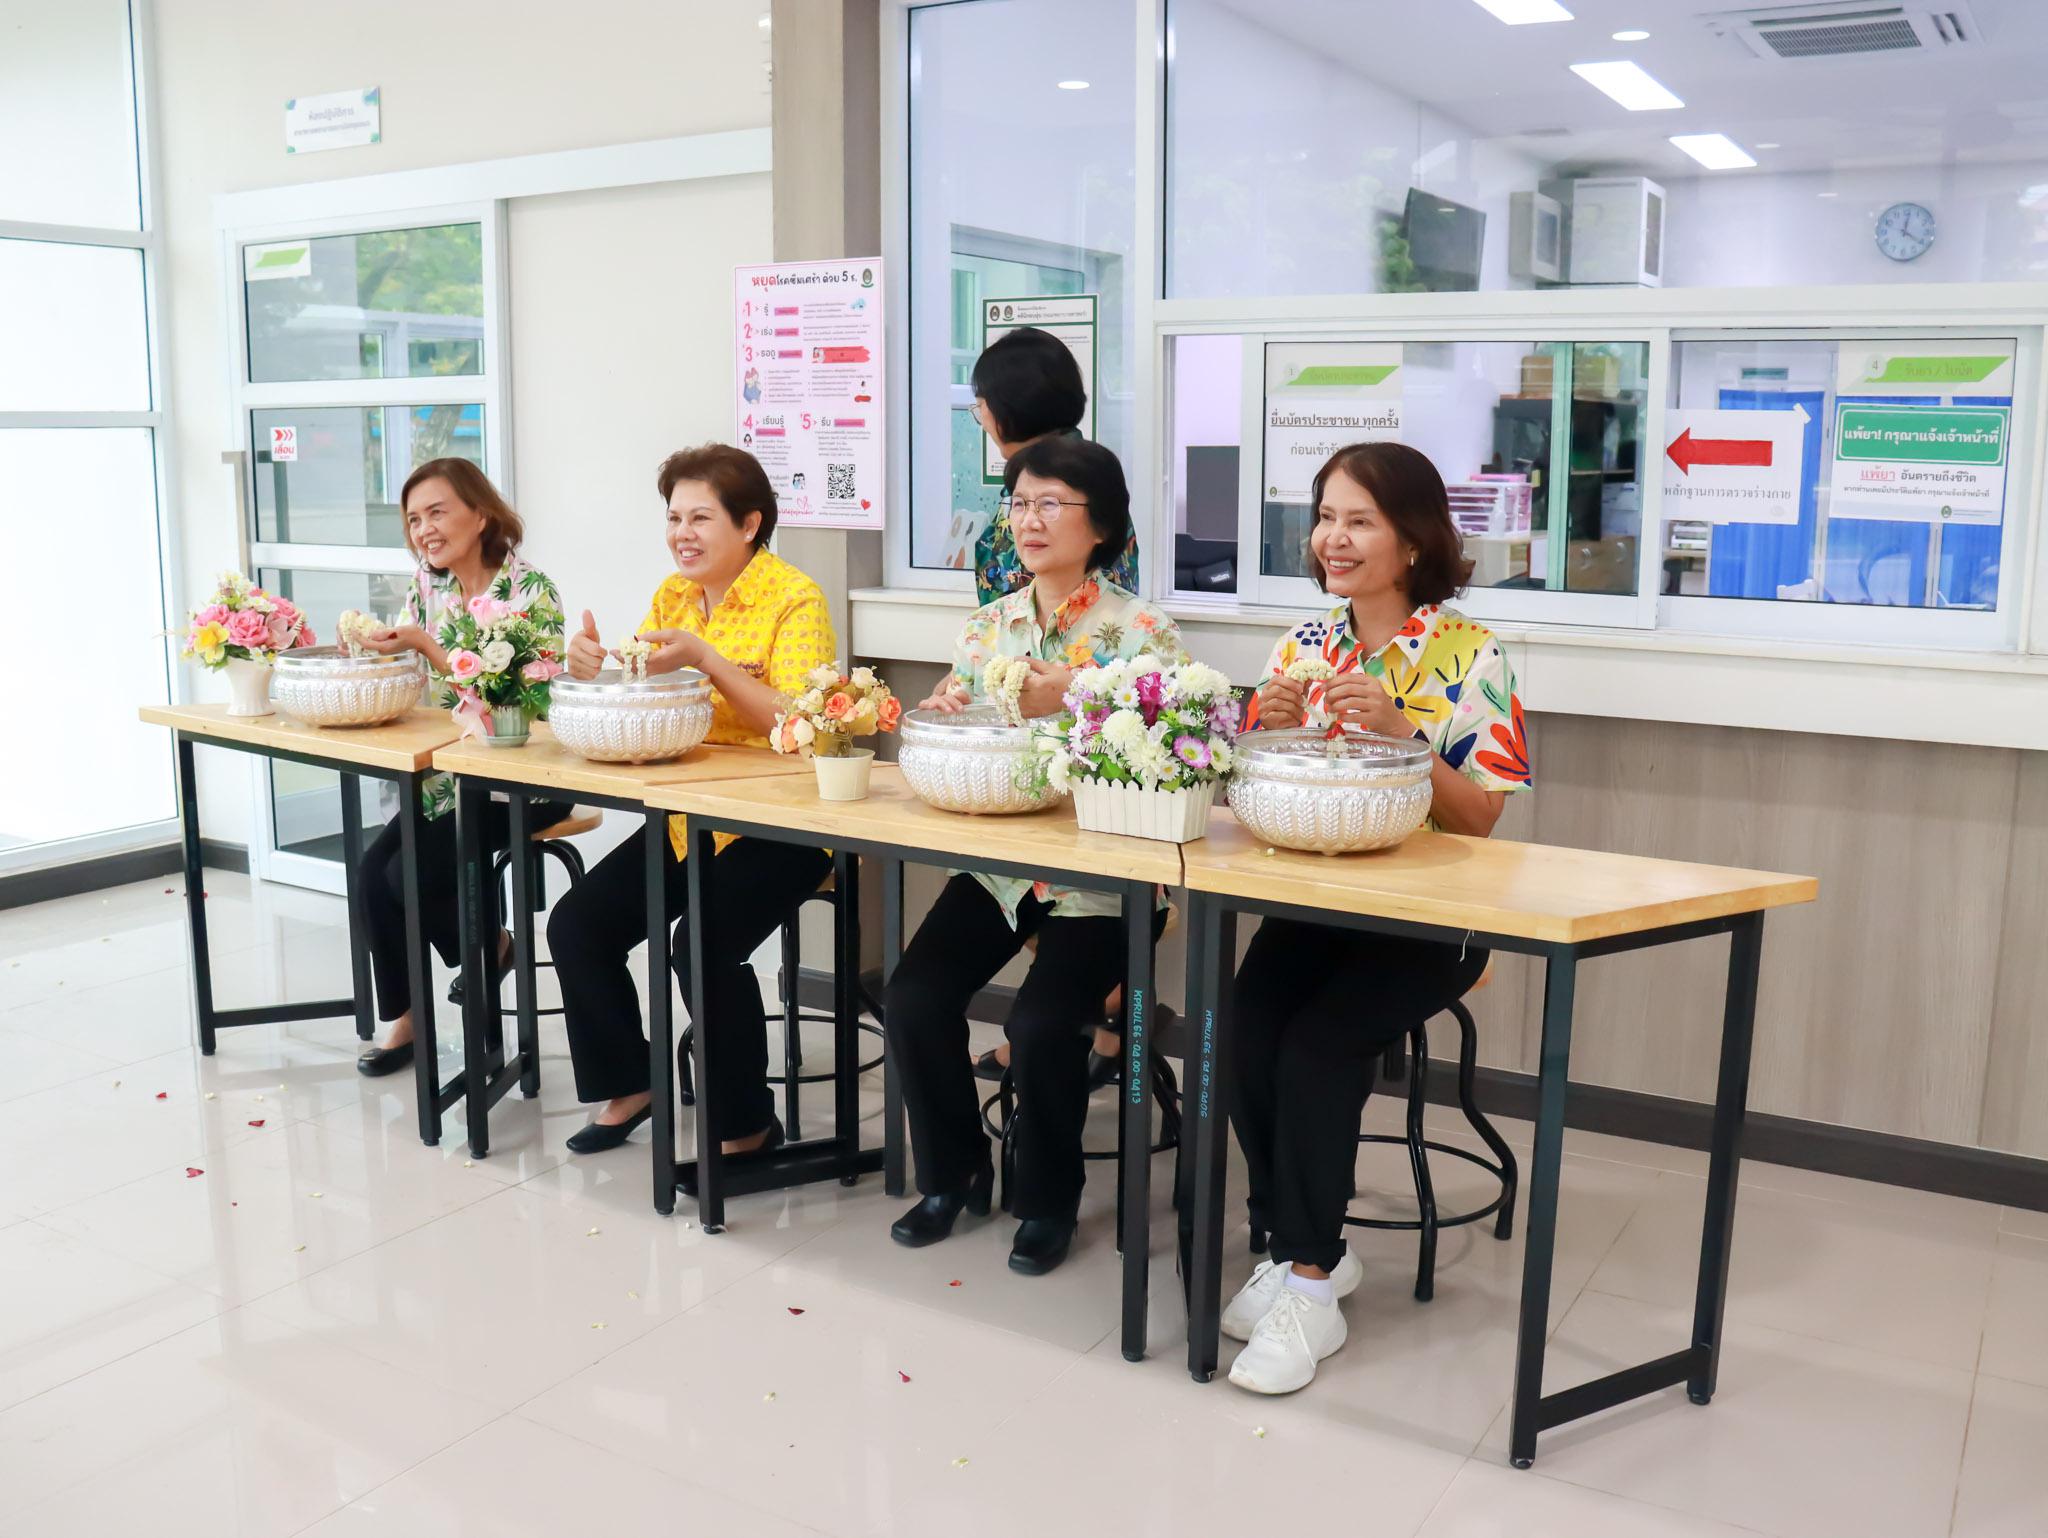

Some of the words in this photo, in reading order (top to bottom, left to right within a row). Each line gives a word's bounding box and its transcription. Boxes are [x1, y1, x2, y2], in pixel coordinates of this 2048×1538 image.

[842, 270, 849, 282] 5
[744, 301, 751, 317] 1
[744, 323, 751, 339] 2
[745, 347, 753, 362] 3
[744, 414, 753, 430] 4
[802, 413, 811, 430] 5
[1271, 409, 1359, 426] ยื่นบัตรประชาชน
[1363, 409, 1398, 430] ทุกครั้ง
[1844, 426, 1881, 440] แพ้ยา!
[1884, 426, 1999, 445] กรุณาแจ้งเจ้าหน้าที่
[1861, 465, 1896, 480] แพ้ยา
[1900, 469, 1977, 483] อันตรายถึงชีวิต
